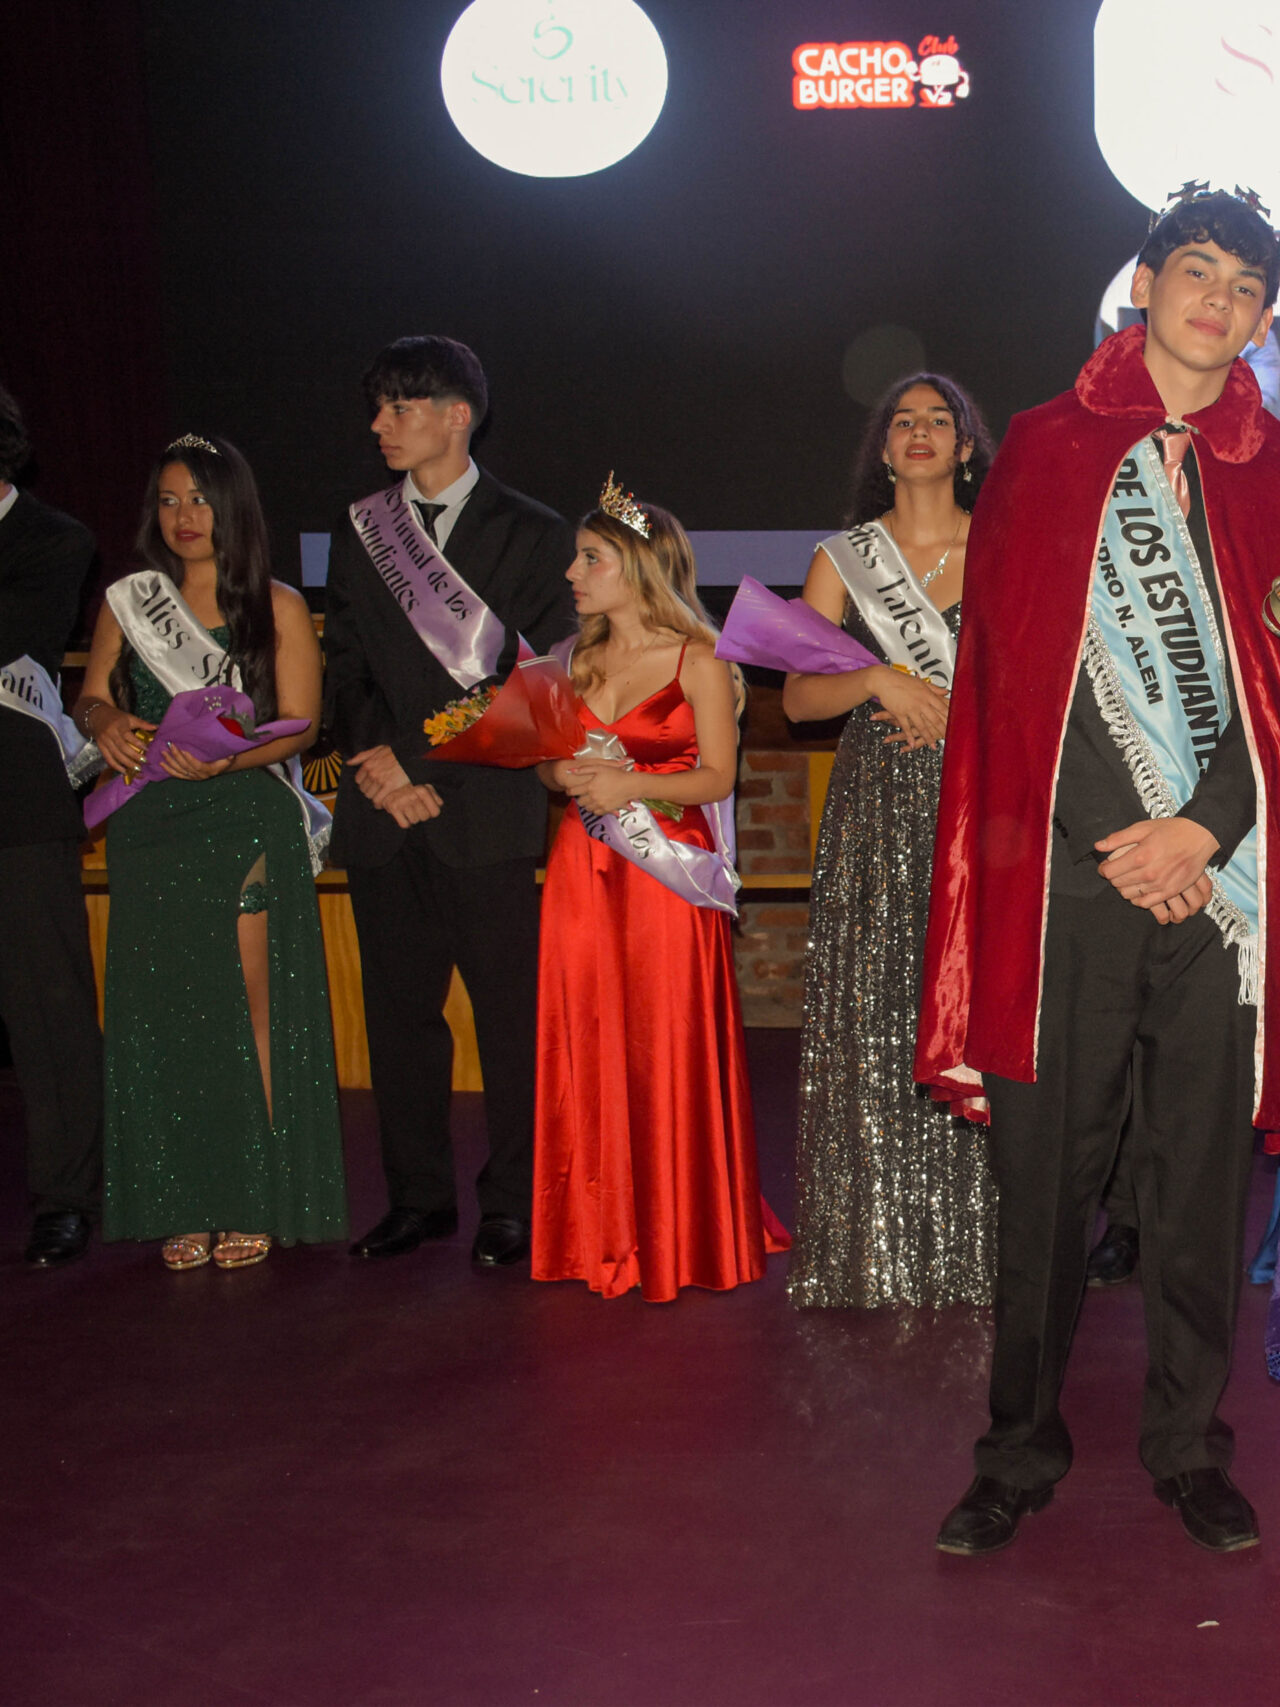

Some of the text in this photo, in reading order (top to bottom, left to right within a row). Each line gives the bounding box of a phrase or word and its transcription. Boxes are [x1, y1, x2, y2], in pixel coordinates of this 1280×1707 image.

[799, 48, 907, 76] CACHO
[918, 35, 958, 56] Club
[799, 78, 908, 104] BURGER
[1111, 458, 1148, 498] DE
[353, 508, 420, 614] estudiantes
[1115, 507, 1171, 567] LOS
[427, 571, 448, 594] de
[444, 590, 472, 621] los
[876, 570, 949, 689] Talento
[1115, 604, 1136, 630] N.
[1126, 635, 1163, 706] ALEM
